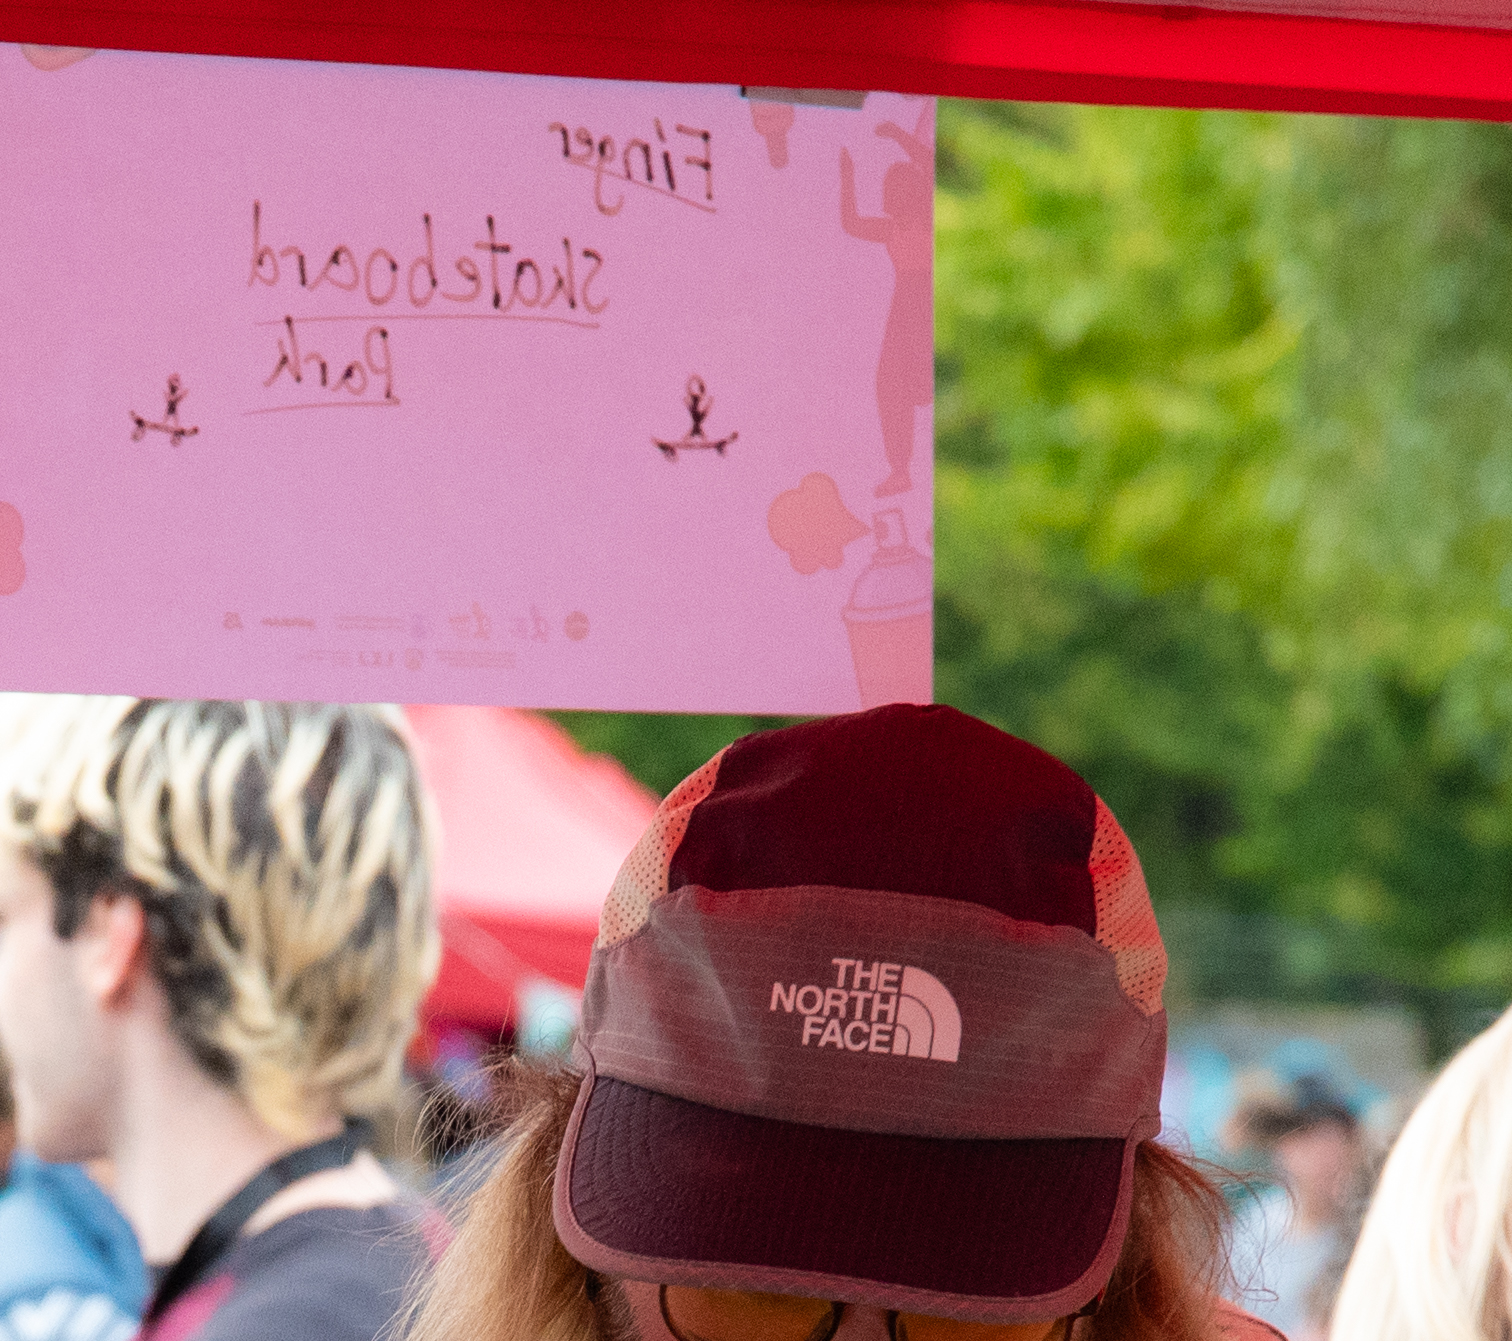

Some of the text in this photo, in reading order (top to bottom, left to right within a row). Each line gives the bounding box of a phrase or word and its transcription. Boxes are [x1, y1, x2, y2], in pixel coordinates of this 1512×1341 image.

[832, 957, 902, 993] THE
[770, 981, 897, 1024] NORTH
[801, 1014, 895, 1055] FACE
